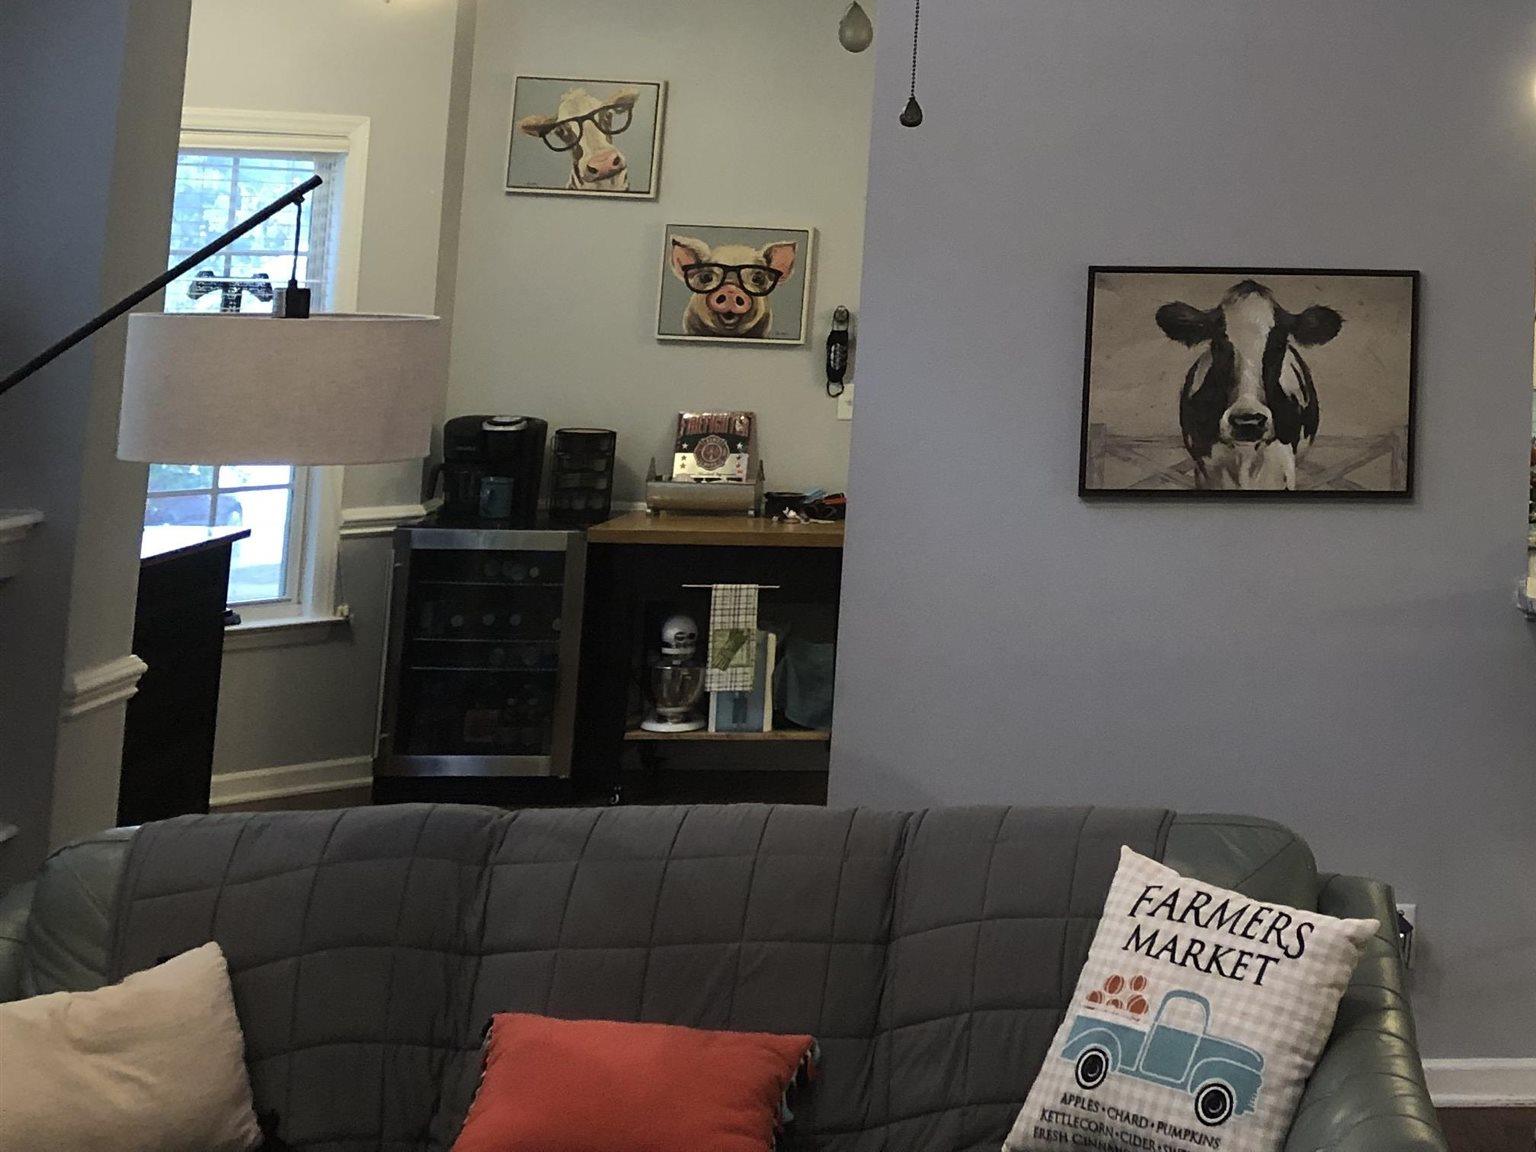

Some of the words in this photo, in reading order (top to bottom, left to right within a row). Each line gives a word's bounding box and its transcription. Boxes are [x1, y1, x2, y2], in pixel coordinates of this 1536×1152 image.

[1128, 885, 1315, 960] FARMERS
[1122, 924, 1280, 986] MARKET
[1033, 1125, 1069, 1145] FRESH
[1040, 1108, 1115, 1139] KETTLECORN
[1120, 1131, 1156, 1150] CIDER
[1060, 1092, 1100, 1113] APPLES
[1107, 1107, 1149, 1129] CHARD
[1156, 1120, 1222, 1150] PUMPKINS
